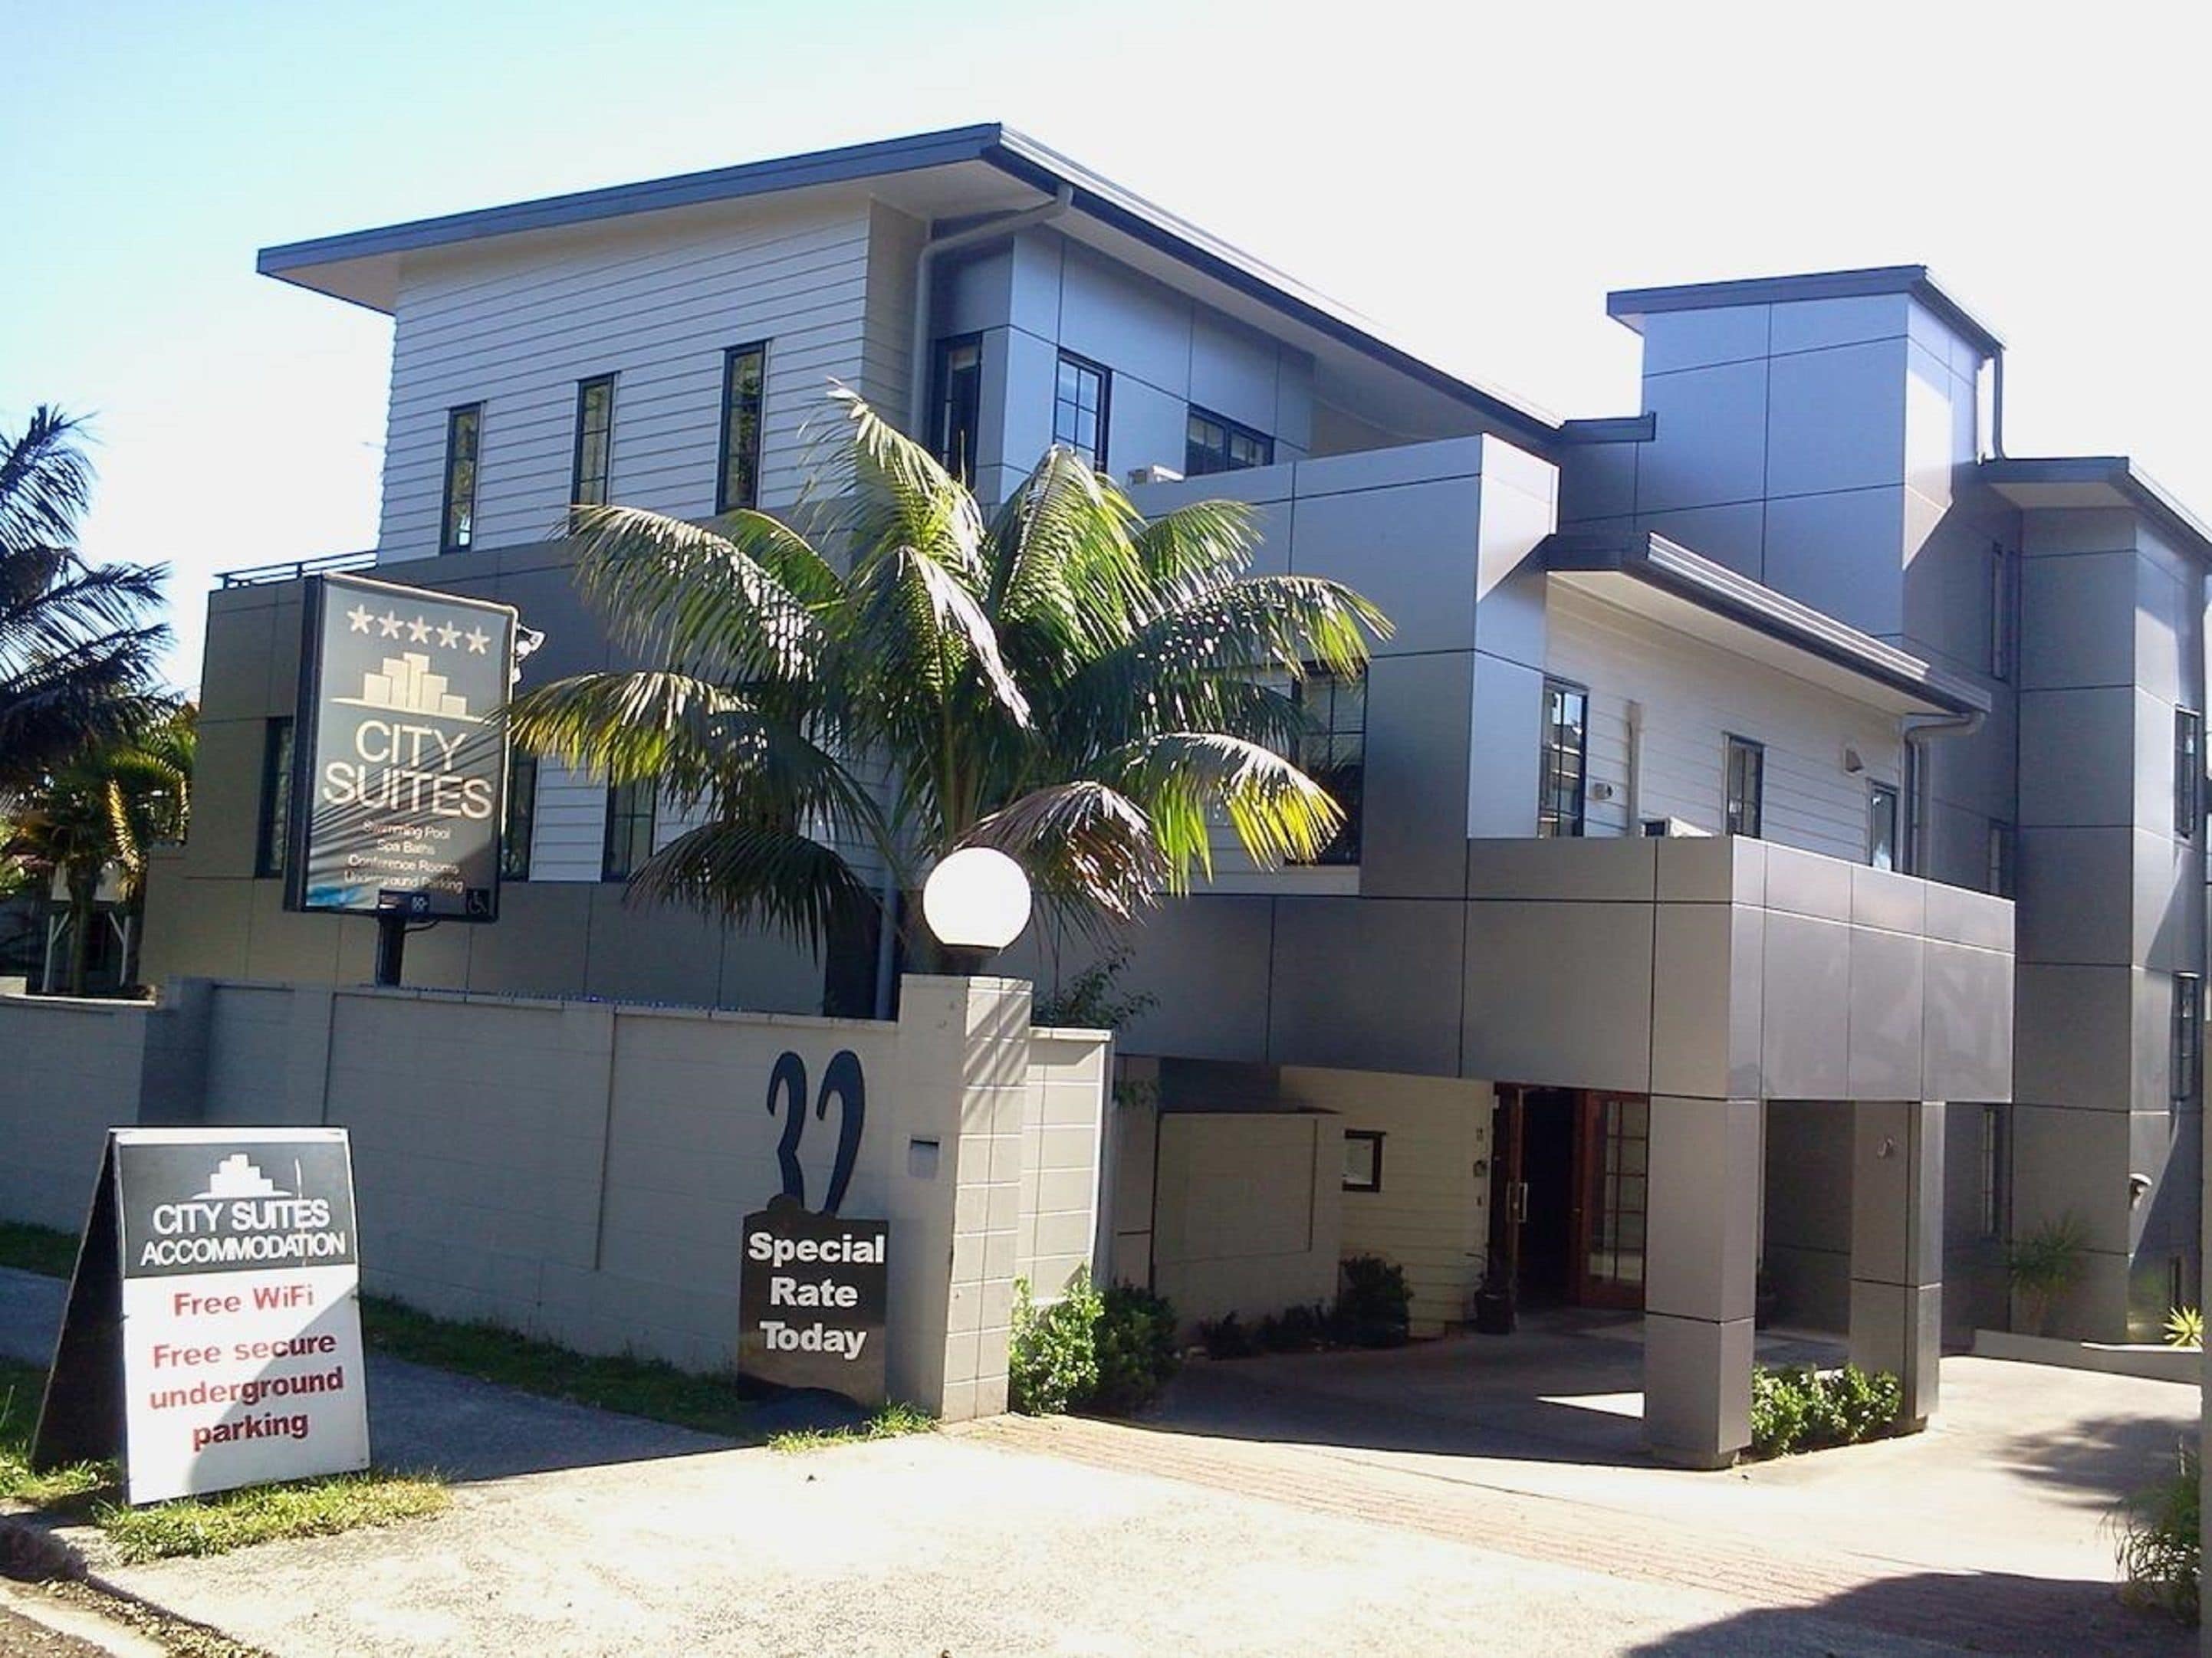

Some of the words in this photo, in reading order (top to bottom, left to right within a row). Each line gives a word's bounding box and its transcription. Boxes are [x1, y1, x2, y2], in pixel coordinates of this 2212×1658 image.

[355, 721, 467, 771] CITY
[323, 762, 492, 819] SUITES
[377, 839, 400, 853] Spa
[424, 826, 451, 839] Pool
[419, 859, 459, 875] Rooms
[153, 1202, 223, 1236] CITY
[232, 1199, 330, 1230] SUITES
[140, 1232, 346, 1266] ACCOMMODATION
[748, 1231, 885, 1267] Special
[173, 1292, 242, 1317] Free
[254, 1284, 314, 1311] WiFi
[771, 1276, 859, 1307] Rate
[153, 1344, 221, 1368] Free
[235, 1334, 337, 1361] secure
[759, 1321, 867, 1361] Today
[150, 1366, 343, 1410] underground
[192, 1414, 308, 1452] parking
